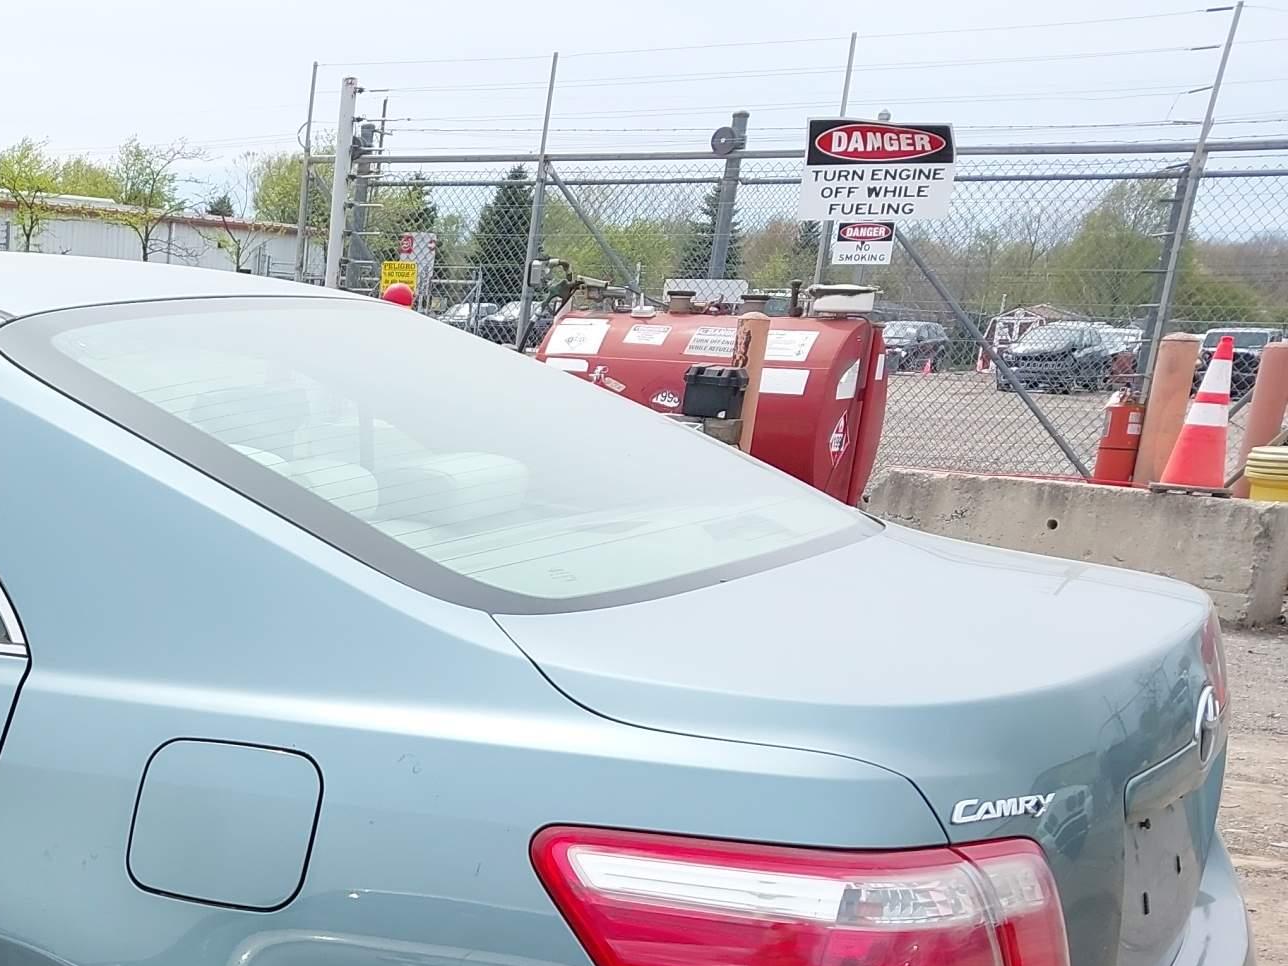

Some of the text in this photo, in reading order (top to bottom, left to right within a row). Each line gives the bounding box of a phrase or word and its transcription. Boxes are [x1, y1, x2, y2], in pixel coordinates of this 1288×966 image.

[831, 131, 932, 153] DANGER
[812, 168, 945, 182] TURN ENGINE
[820, 185, 930, 199] OFF WHILE
[828, 203, 915, 215] FUELING
[846, 226, 886, 238] DANGER
[855, 243, 871, 252] NO
[838, 254, 886, 262] SMOKING
[951, 793, 1056, 824] CAMRY
